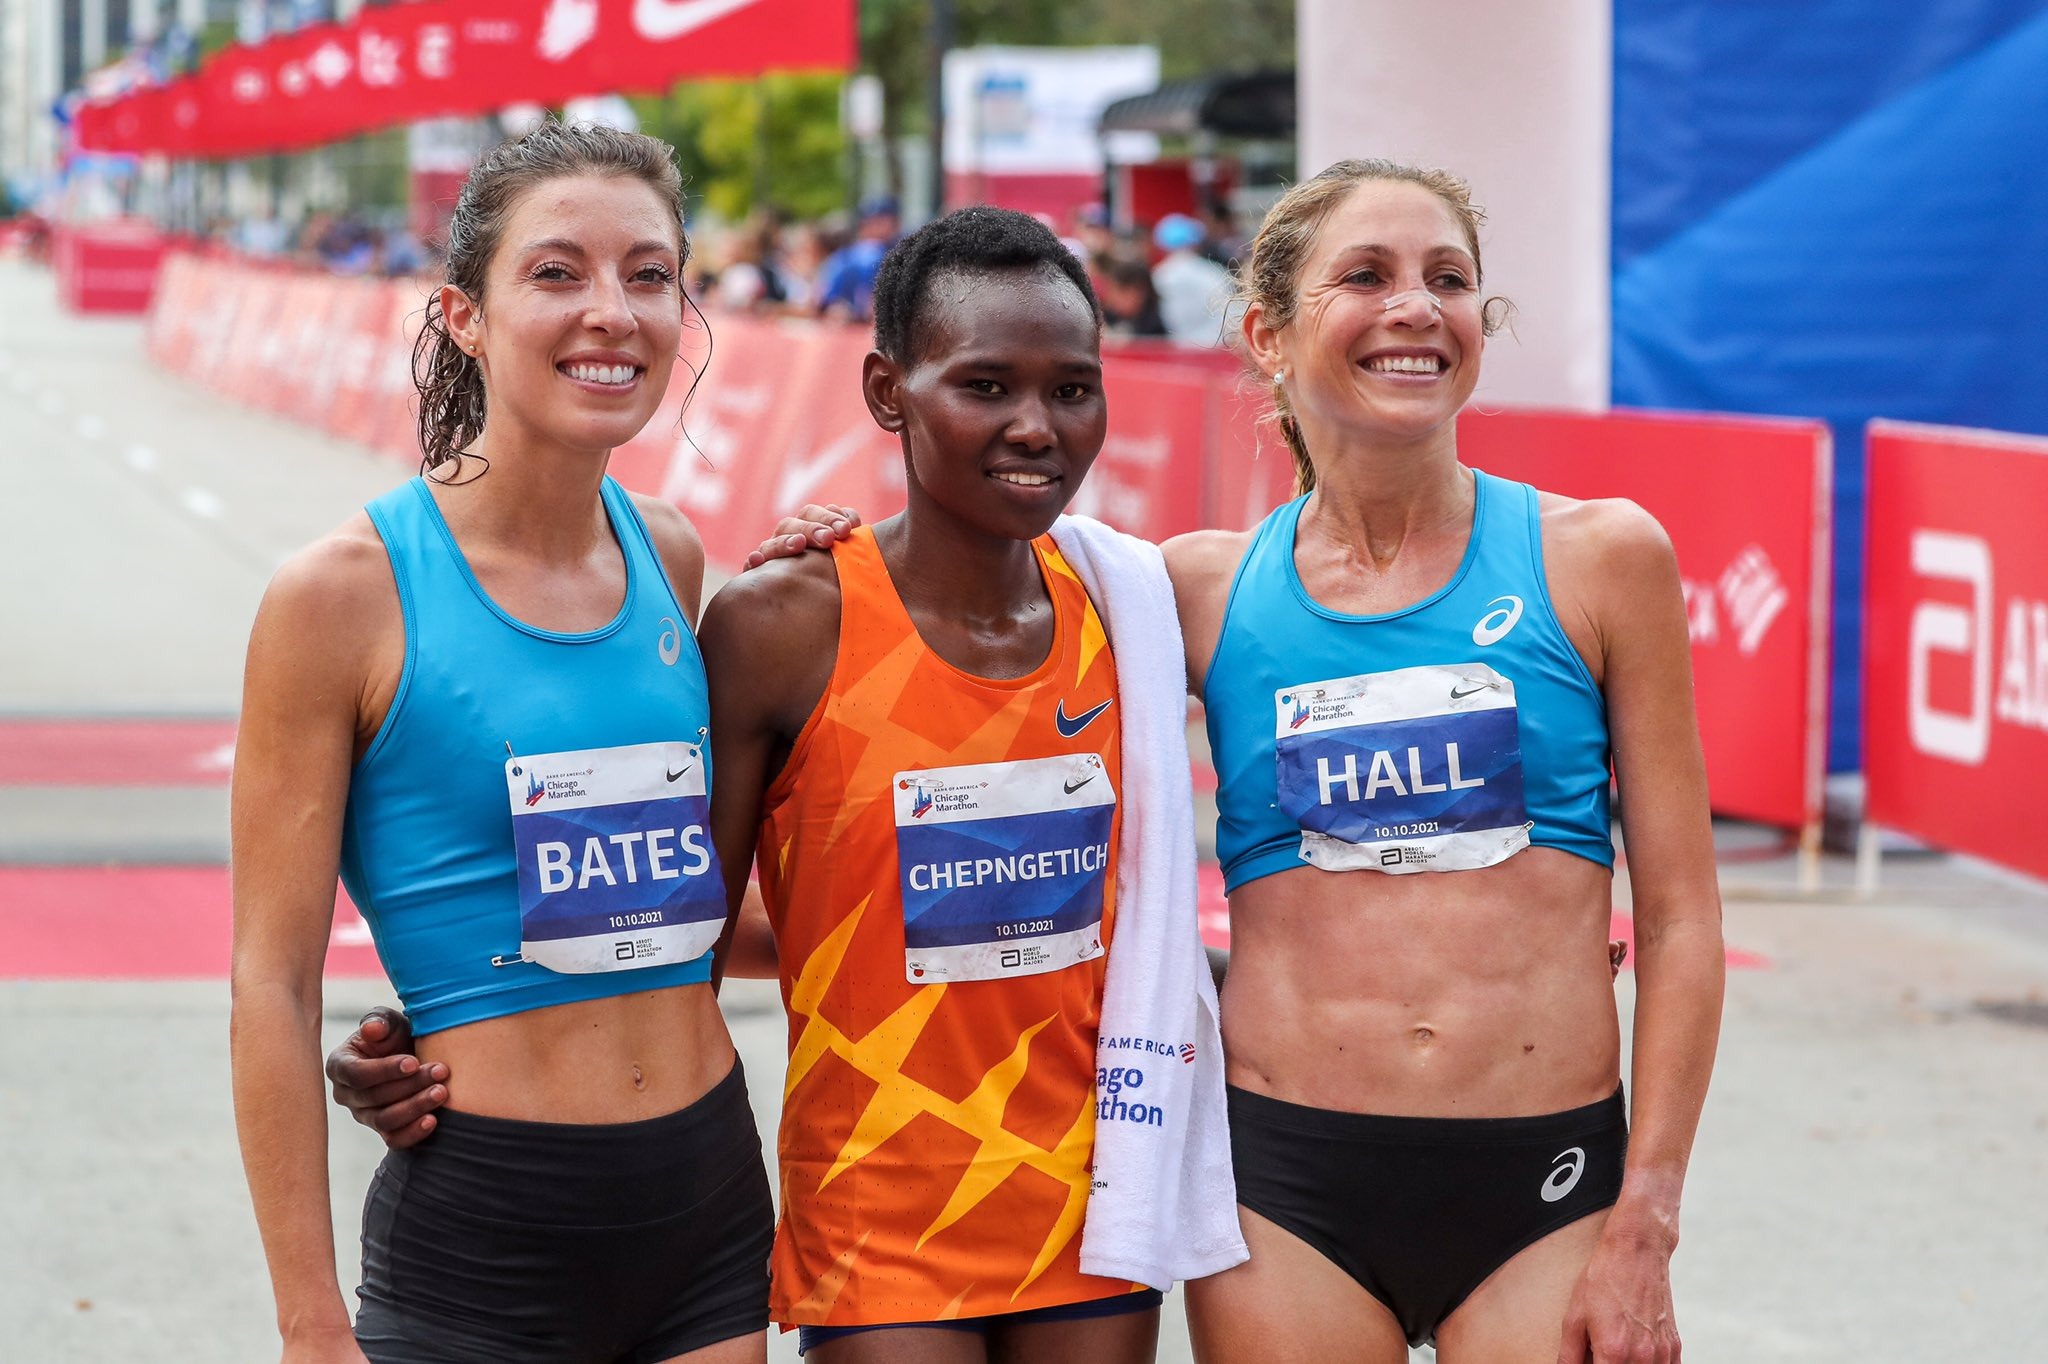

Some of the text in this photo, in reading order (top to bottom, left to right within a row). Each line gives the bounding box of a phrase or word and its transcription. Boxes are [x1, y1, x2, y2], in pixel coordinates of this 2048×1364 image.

[1312, 704, 1345, 713] Chicago
[1312, 710, 1353, 722] Marathon
[1316, 742, 1485, 806] HALL
[547, 780, 578, 790] Chicago
[548, 789, 586, 799] Marathon
[934, 794, 969, 803] Chicago
[936, 802, 978, 812] Marathon
[1374, 821, 1439, 838] 10.10.2021
[536, 825, 710, 894] BATES
[909, 842, 1108, 891] CHEPNGETICH
[609, 911, 663, 928] 10.10.2021
[996, 919, 1053, 936] 10.10.2021
[1107, 1037, 1175, 1057] AMERICA
[1097, 1067, 1143, 1094] ago
